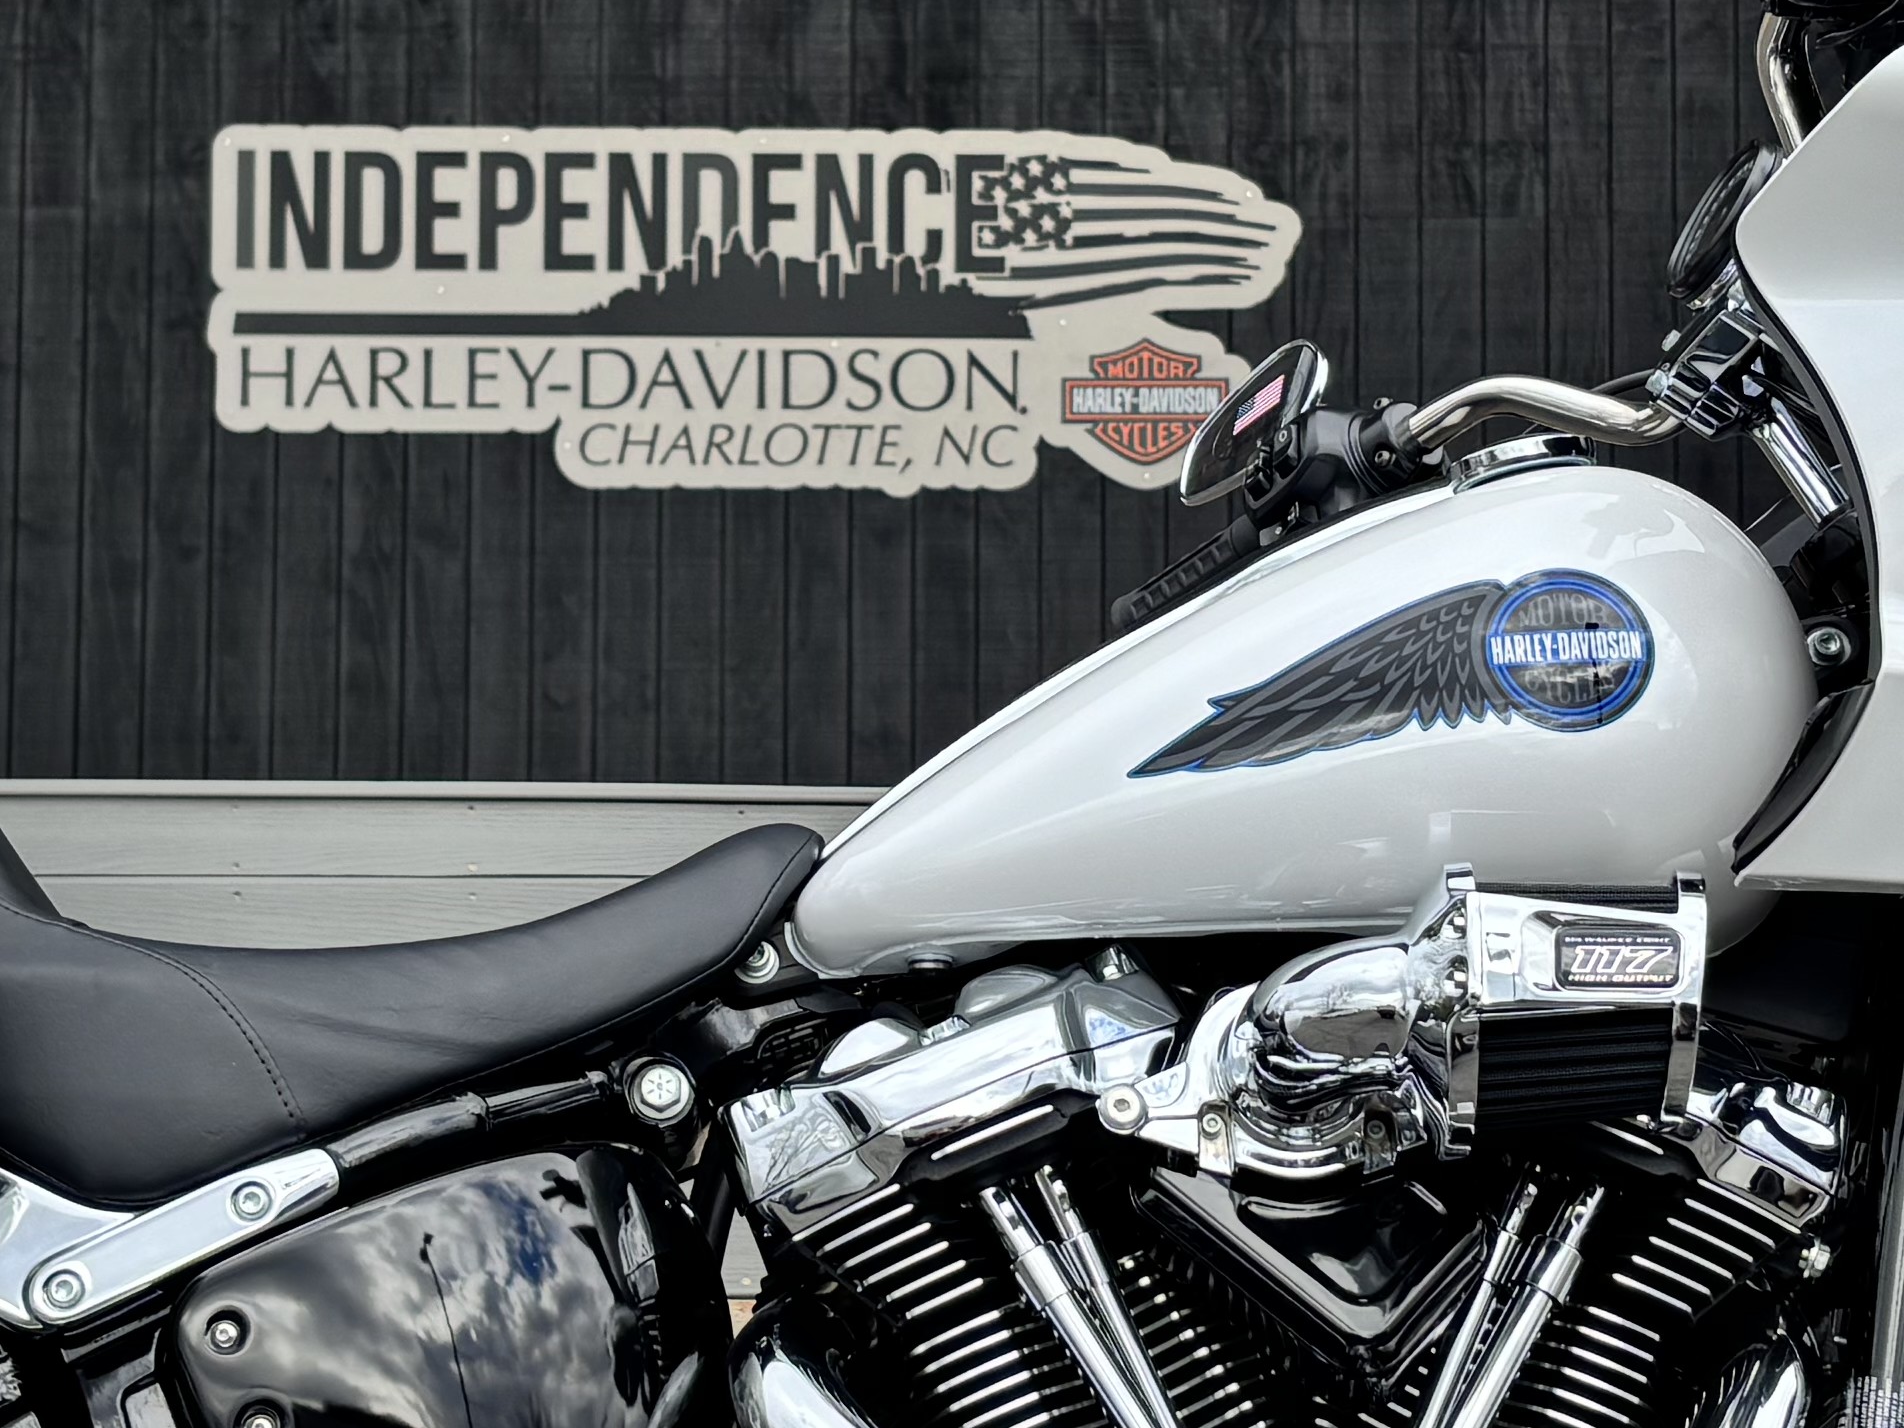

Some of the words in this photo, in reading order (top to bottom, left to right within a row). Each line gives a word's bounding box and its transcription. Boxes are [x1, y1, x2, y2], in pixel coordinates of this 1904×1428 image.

[234, 149, 1006, 274] INDEPENDENCE
[1107, 351, 1184, 379] MOTOR
[1072, 386, 1219, 413] HARLEY-DAVIDSON
[577, 424, 911, 475] CHARLOTTE,
[937, 425, 1019, 469] NC
[1107, 422, 1185, 454] CYCLES
[1490, 630, 1642, 665] HARLEY-DAVIDSON
[1570, 945, 1673, 973] 117
